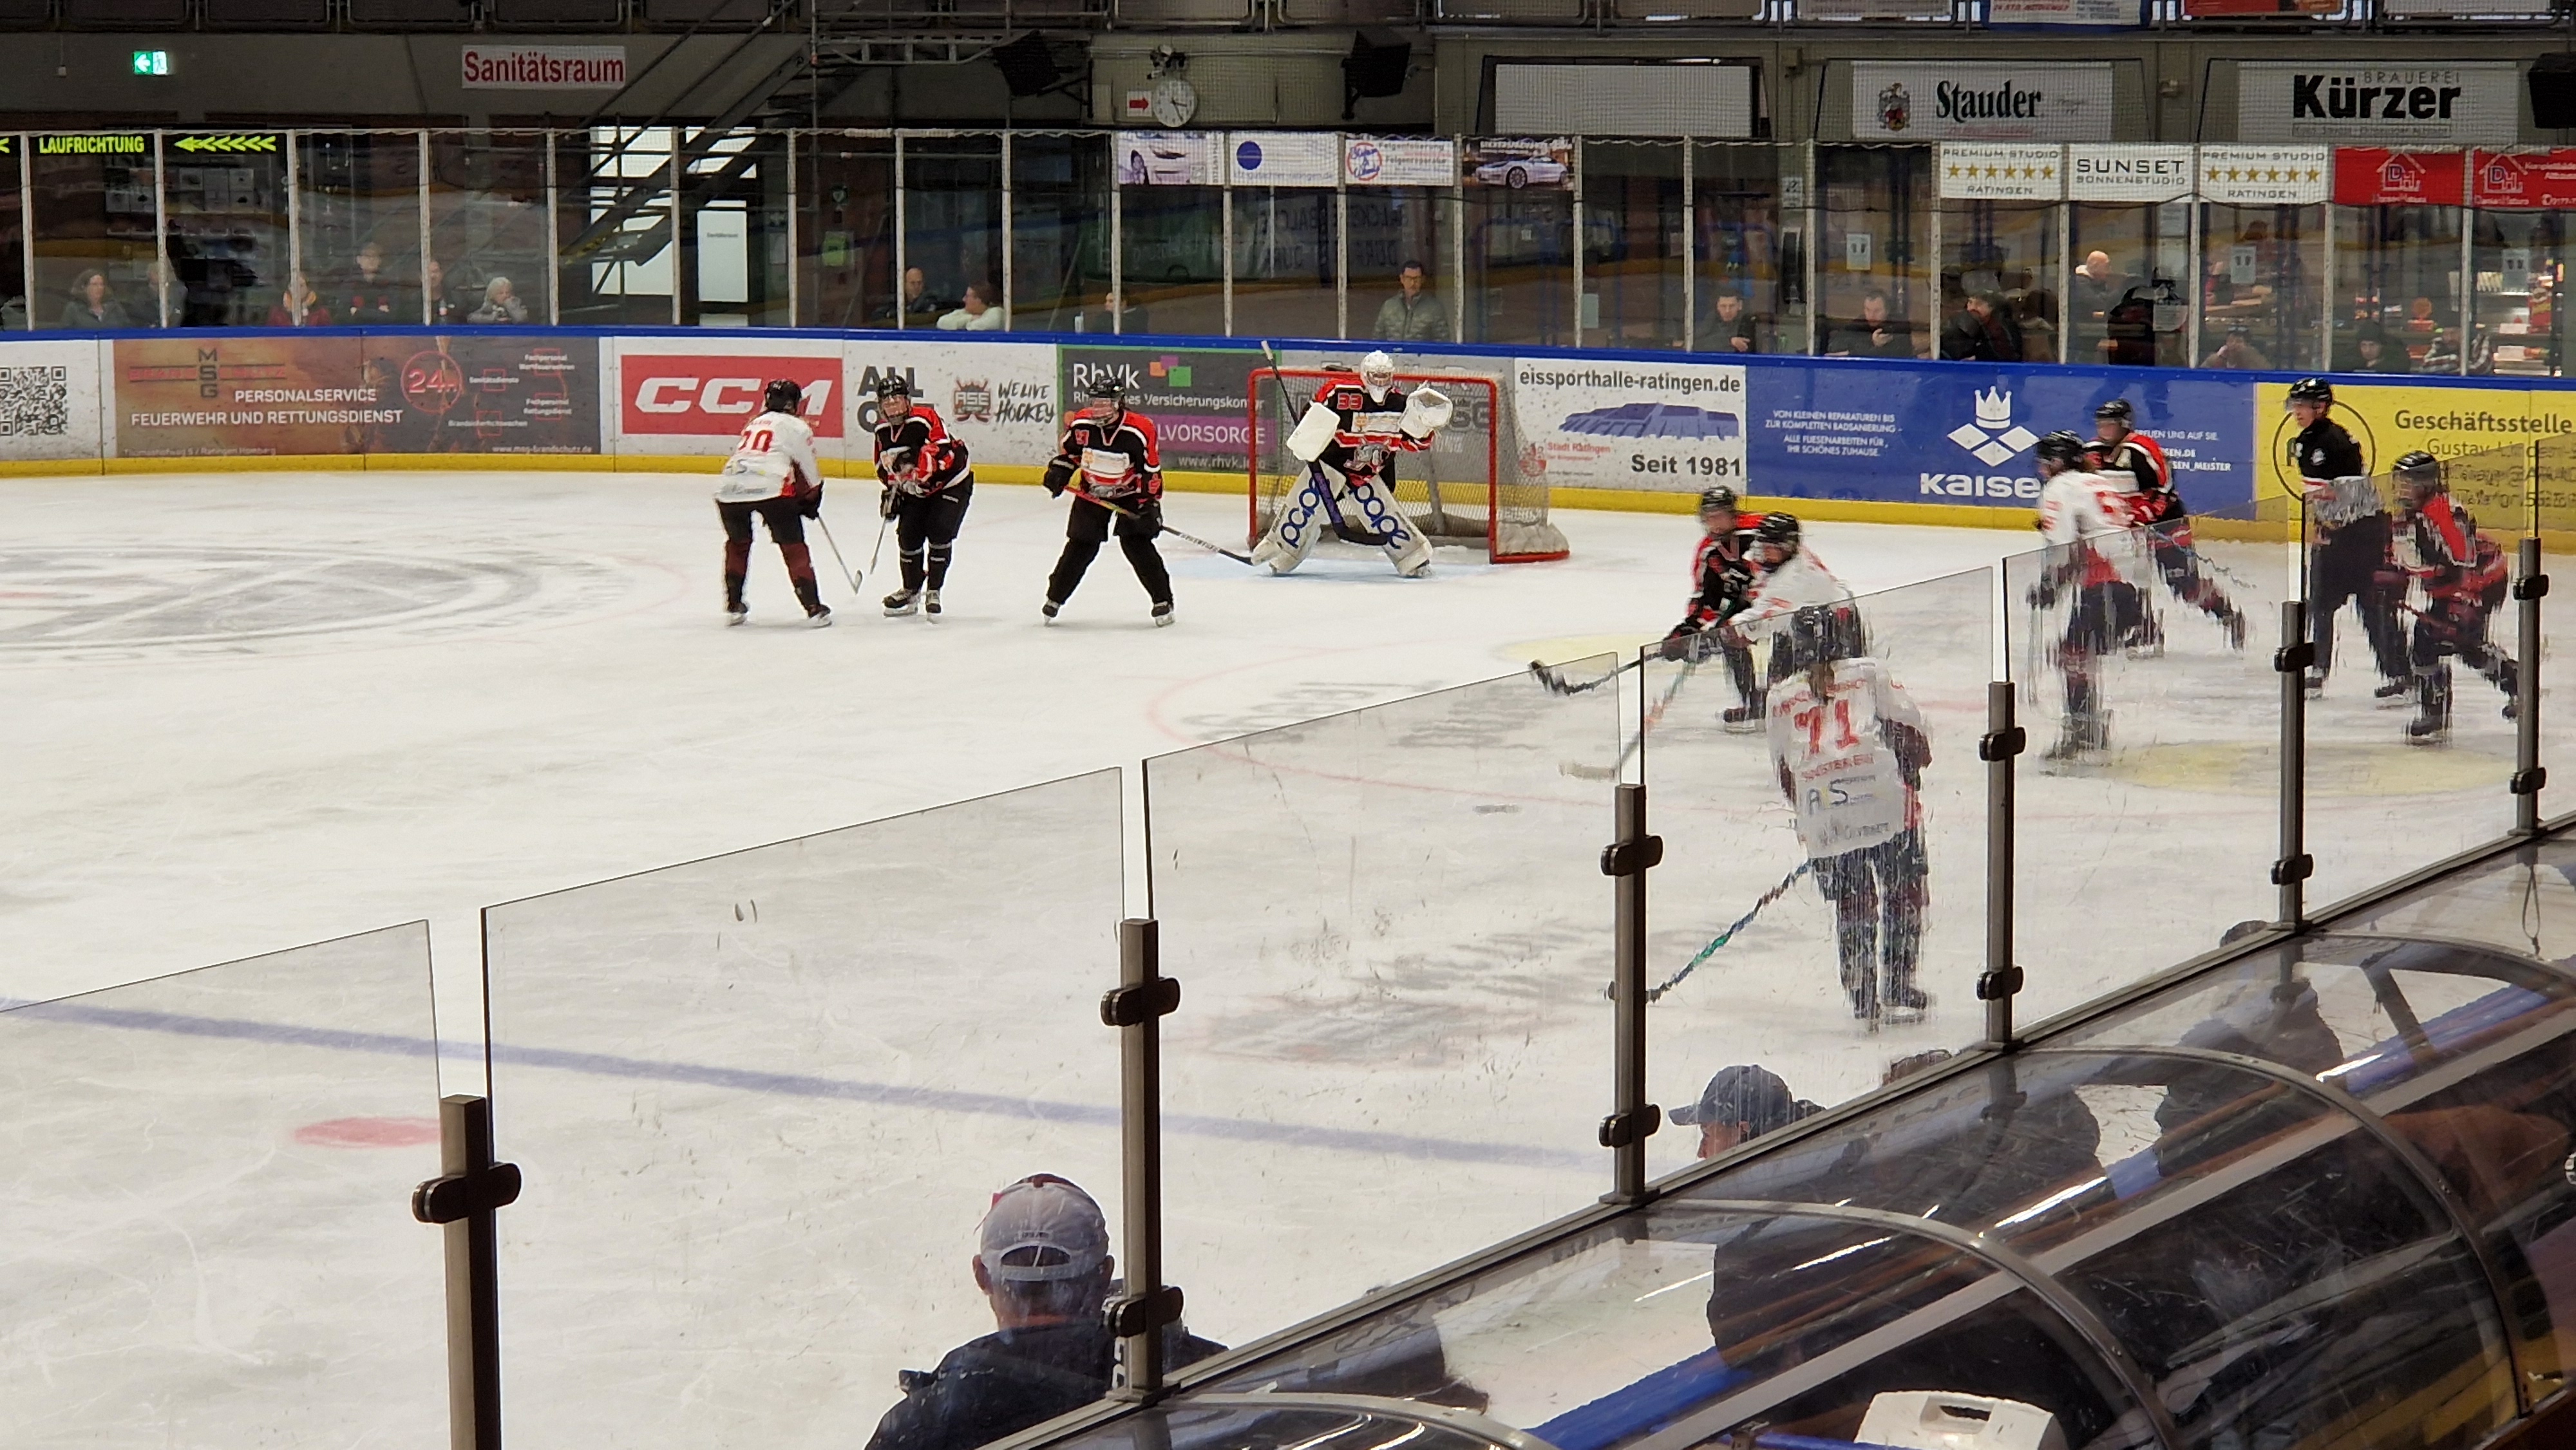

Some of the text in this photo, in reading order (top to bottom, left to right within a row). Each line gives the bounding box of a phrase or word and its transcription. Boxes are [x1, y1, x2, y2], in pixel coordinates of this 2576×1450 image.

[464, 52, 625, 83] Sanitätsraum
[2363, 71, 2460, 84] BRAUEREI
[1936, 79, 2041, 123] Stauder
[2293, 75, 2461, 118] Kürzer
[39, 136, 144, 153] LAUFRICHTUNG
[1944, 148, 2060, 158] PREMIUM STUDIO
[2202, 151, 2325, 161] PREMIUM STUDIO
[2076, 158, 2185, 174] SUNSET
[2076, 176, 2186, 185] SONNENSTUDIO
[1967, 185, 2033, 194] RATINGEN
[2227, 190, 2297, 198] RATINGEN
[1520, 368, 1740, 395] eissporthalle-ratingen.de
[235, 388, 377, 403] PERSONALSERVICE
[131, 410, 403, 426] FEUERWEHR UND RETTUNGSDIENST
[995, 399, 1055, 426] HOCKEY
[1794, 411, 1826, 420] KLEINEN
[1828, 412, 1881, 422] REPARATUREN
[1882, 414, 1895, 423] BIS
[1765, 420, 1896, 433] ZUR KOMPLETTEN BADSANIERUNG
[2395, 409, 2573, 434] Geschäftsstelle
[1548, 442, 1611, 454] Stadt Ratingen
[1631, 455, 1740, 476] Seit 1981
